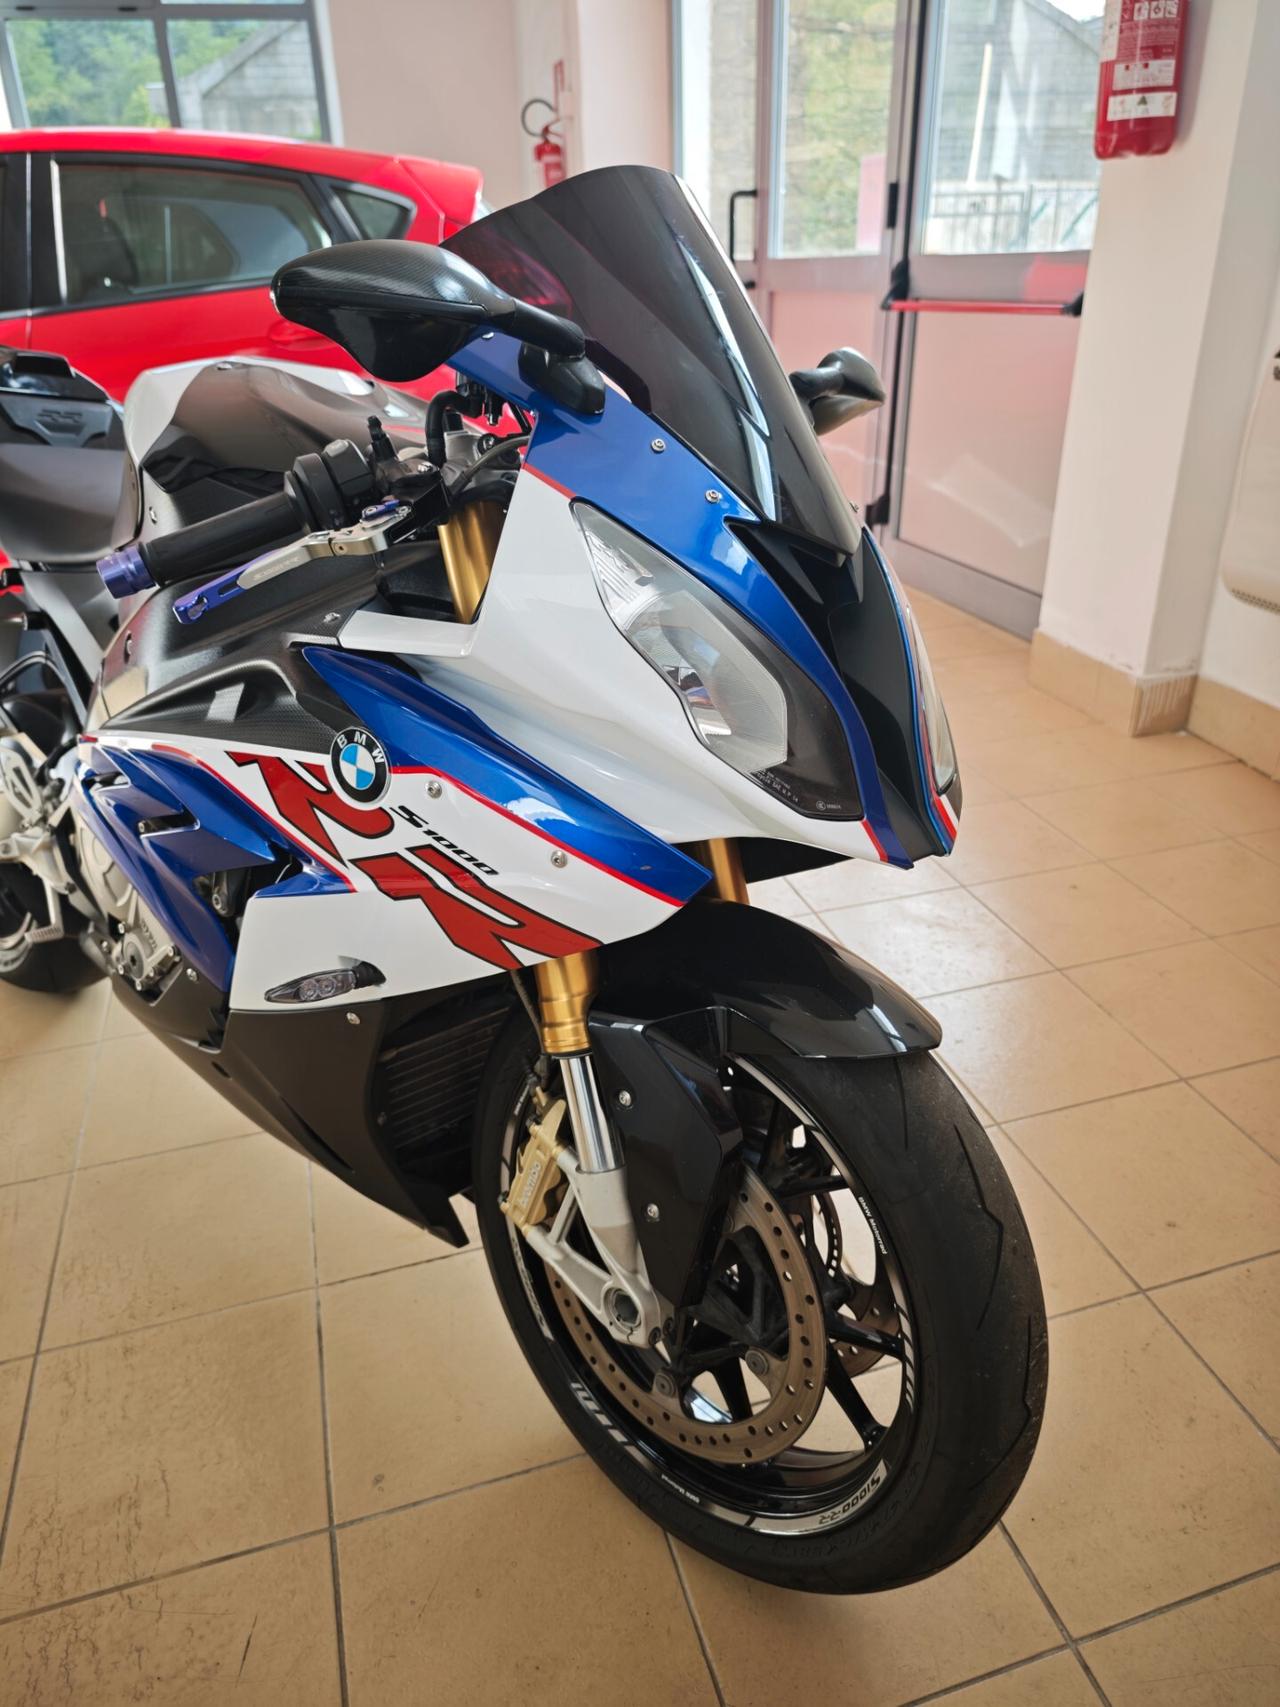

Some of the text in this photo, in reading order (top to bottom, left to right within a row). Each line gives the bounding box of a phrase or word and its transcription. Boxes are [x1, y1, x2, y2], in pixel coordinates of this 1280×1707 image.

[336, 730, 385, 764] BMW
[857, 1195, 888, 1255] BMW Motorrad
